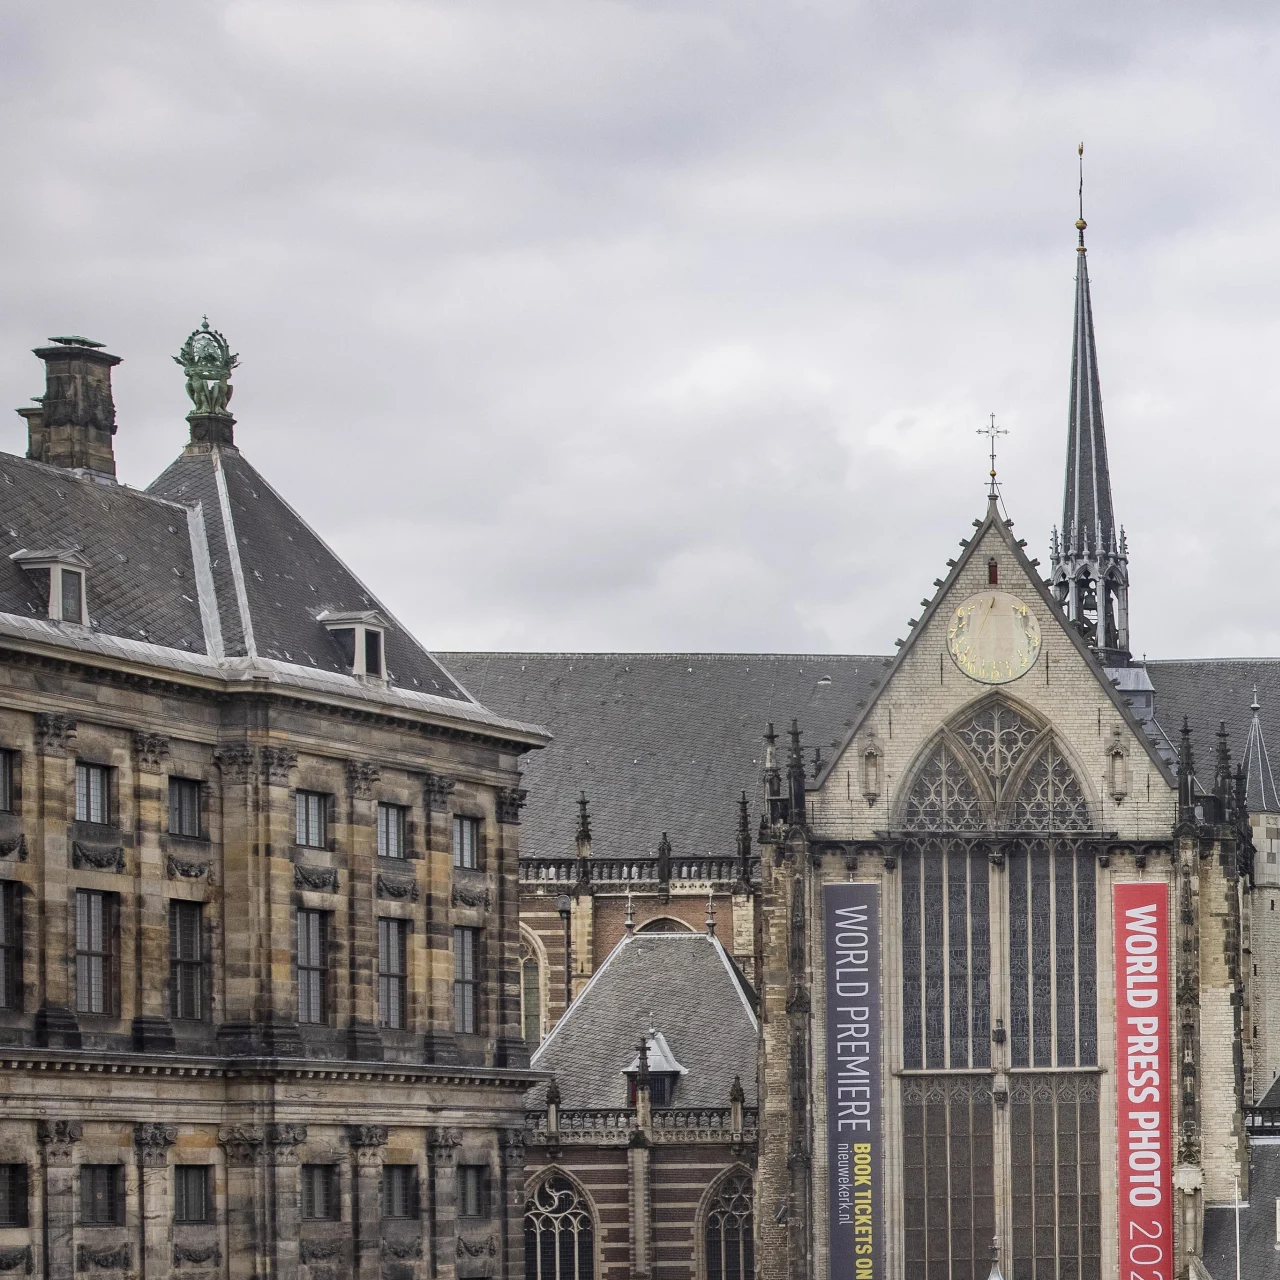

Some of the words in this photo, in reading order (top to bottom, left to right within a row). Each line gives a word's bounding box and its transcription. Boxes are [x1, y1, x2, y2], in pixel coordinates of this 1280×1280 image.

[834, 904, 868, 997] WORLD
[1125, 903, 1158, 1006] WORLD
[836, 1005, 872, 1132] PREMIERE
[1126, 1016, 1160, 1104] PRESS
[837, 1142, 853, 1226] nieuwekerk.nl
[853, 1142, 871, 1184] BOOK
[1127, 1111, 1162, 1208] PHOTO
[853, 1187, 873, 1255] TICKETS
